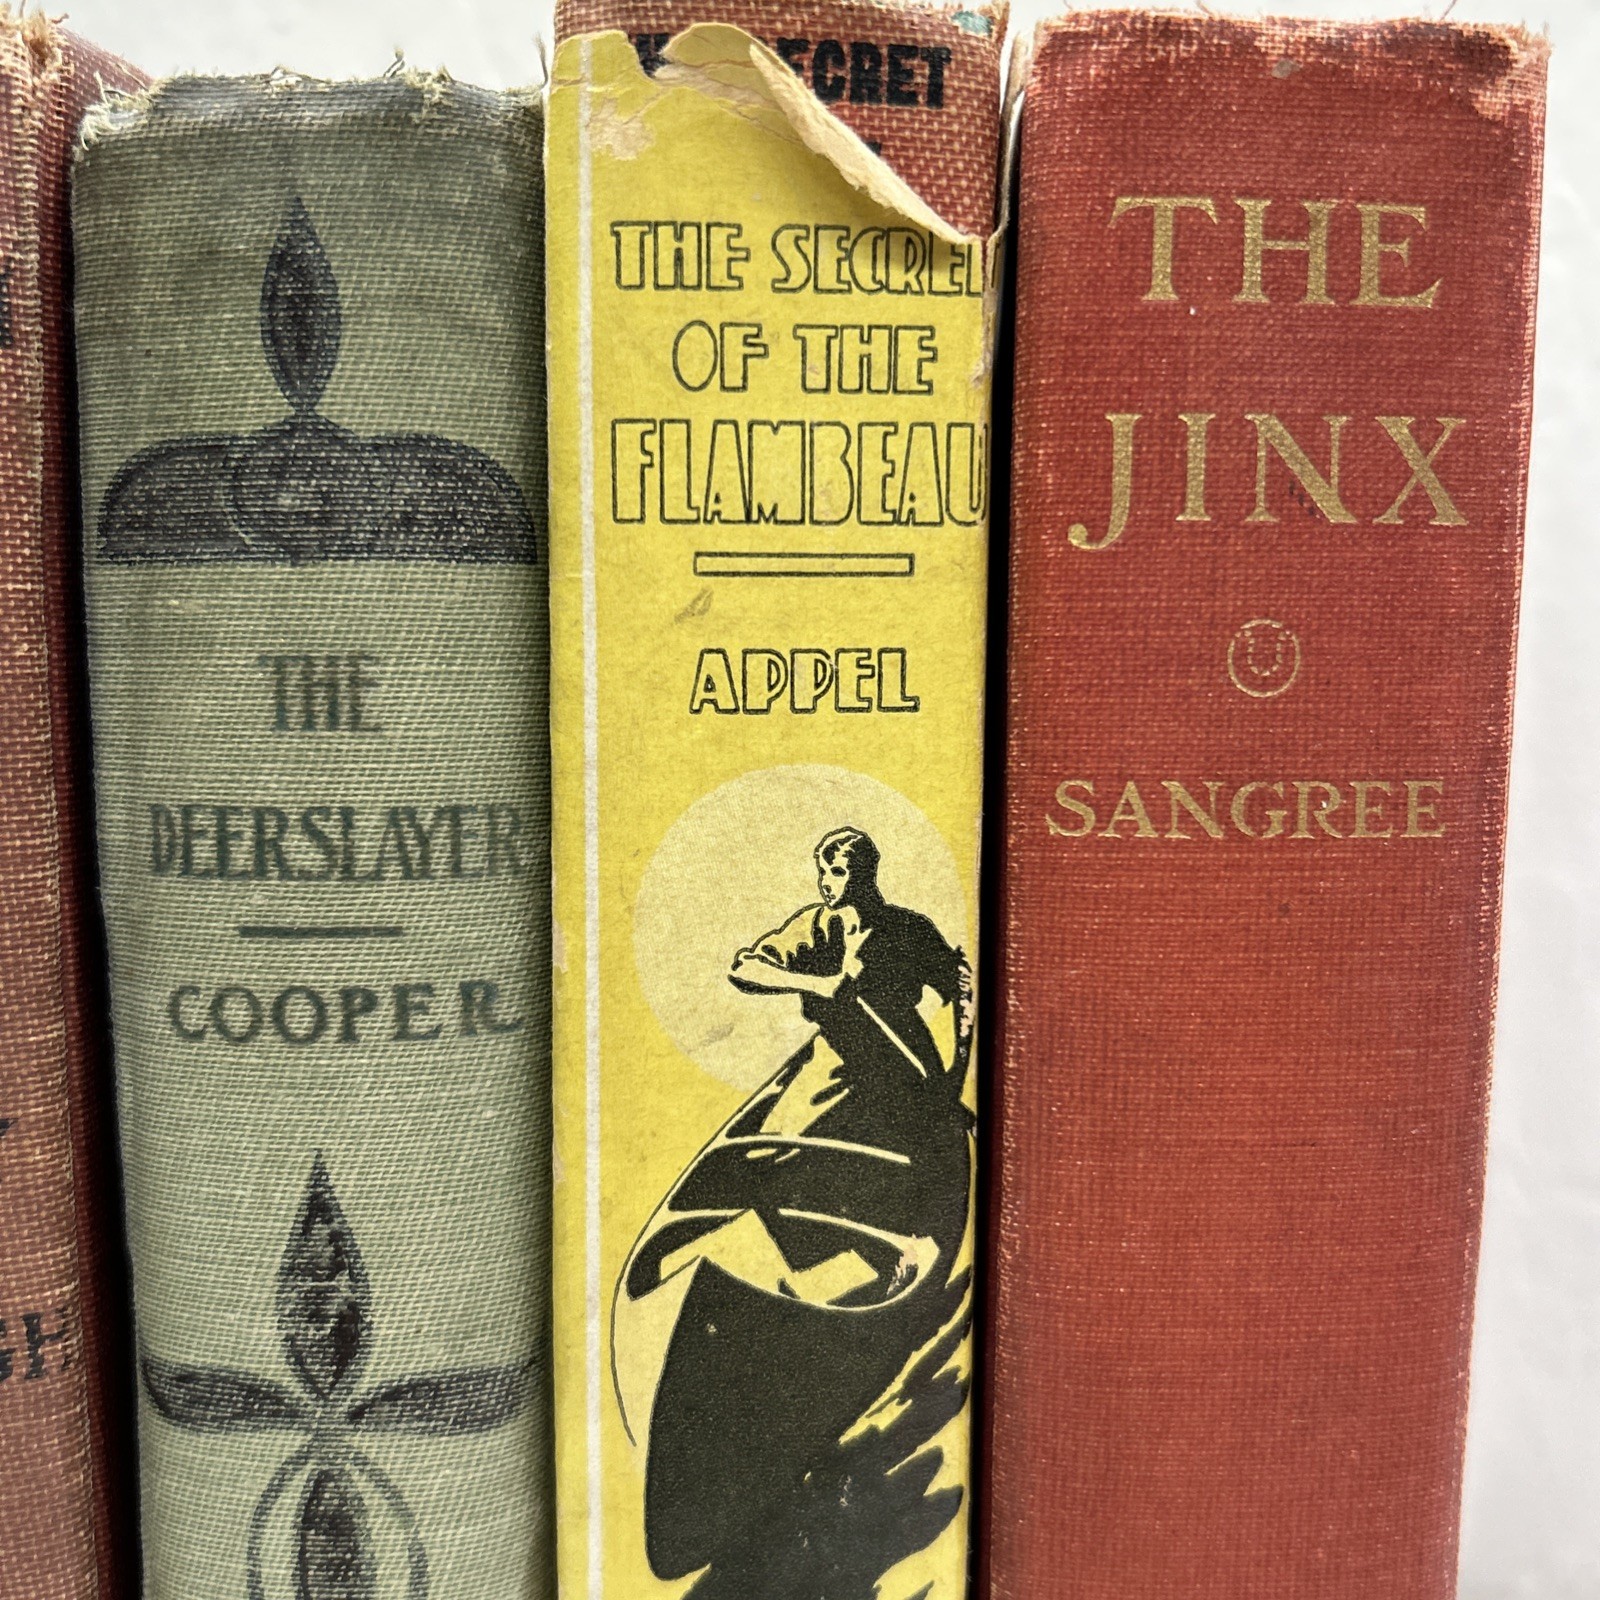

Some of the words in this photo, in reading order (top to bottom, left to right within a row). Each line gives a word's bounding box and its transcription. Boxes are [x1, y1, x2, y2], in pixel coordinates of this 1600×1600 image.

[610, 220, 751, 292] THE
[1108, 196, 1444, 308] THE
[672, 319, 769, 393] OF
[793, 323, 938, 397] THE
[611, 417, 988, 528] FLAMBEAU
[1067, 412, 1469, 551] JINX
[258, 654, 382, 732] THE
[689, 647, 921, 716] APPEL
[150, 803, 526, 881] DEERSLAYER
[1043, 779, 1447, 841] SANGREE
[167, 978, 525, 1045] COOPER
